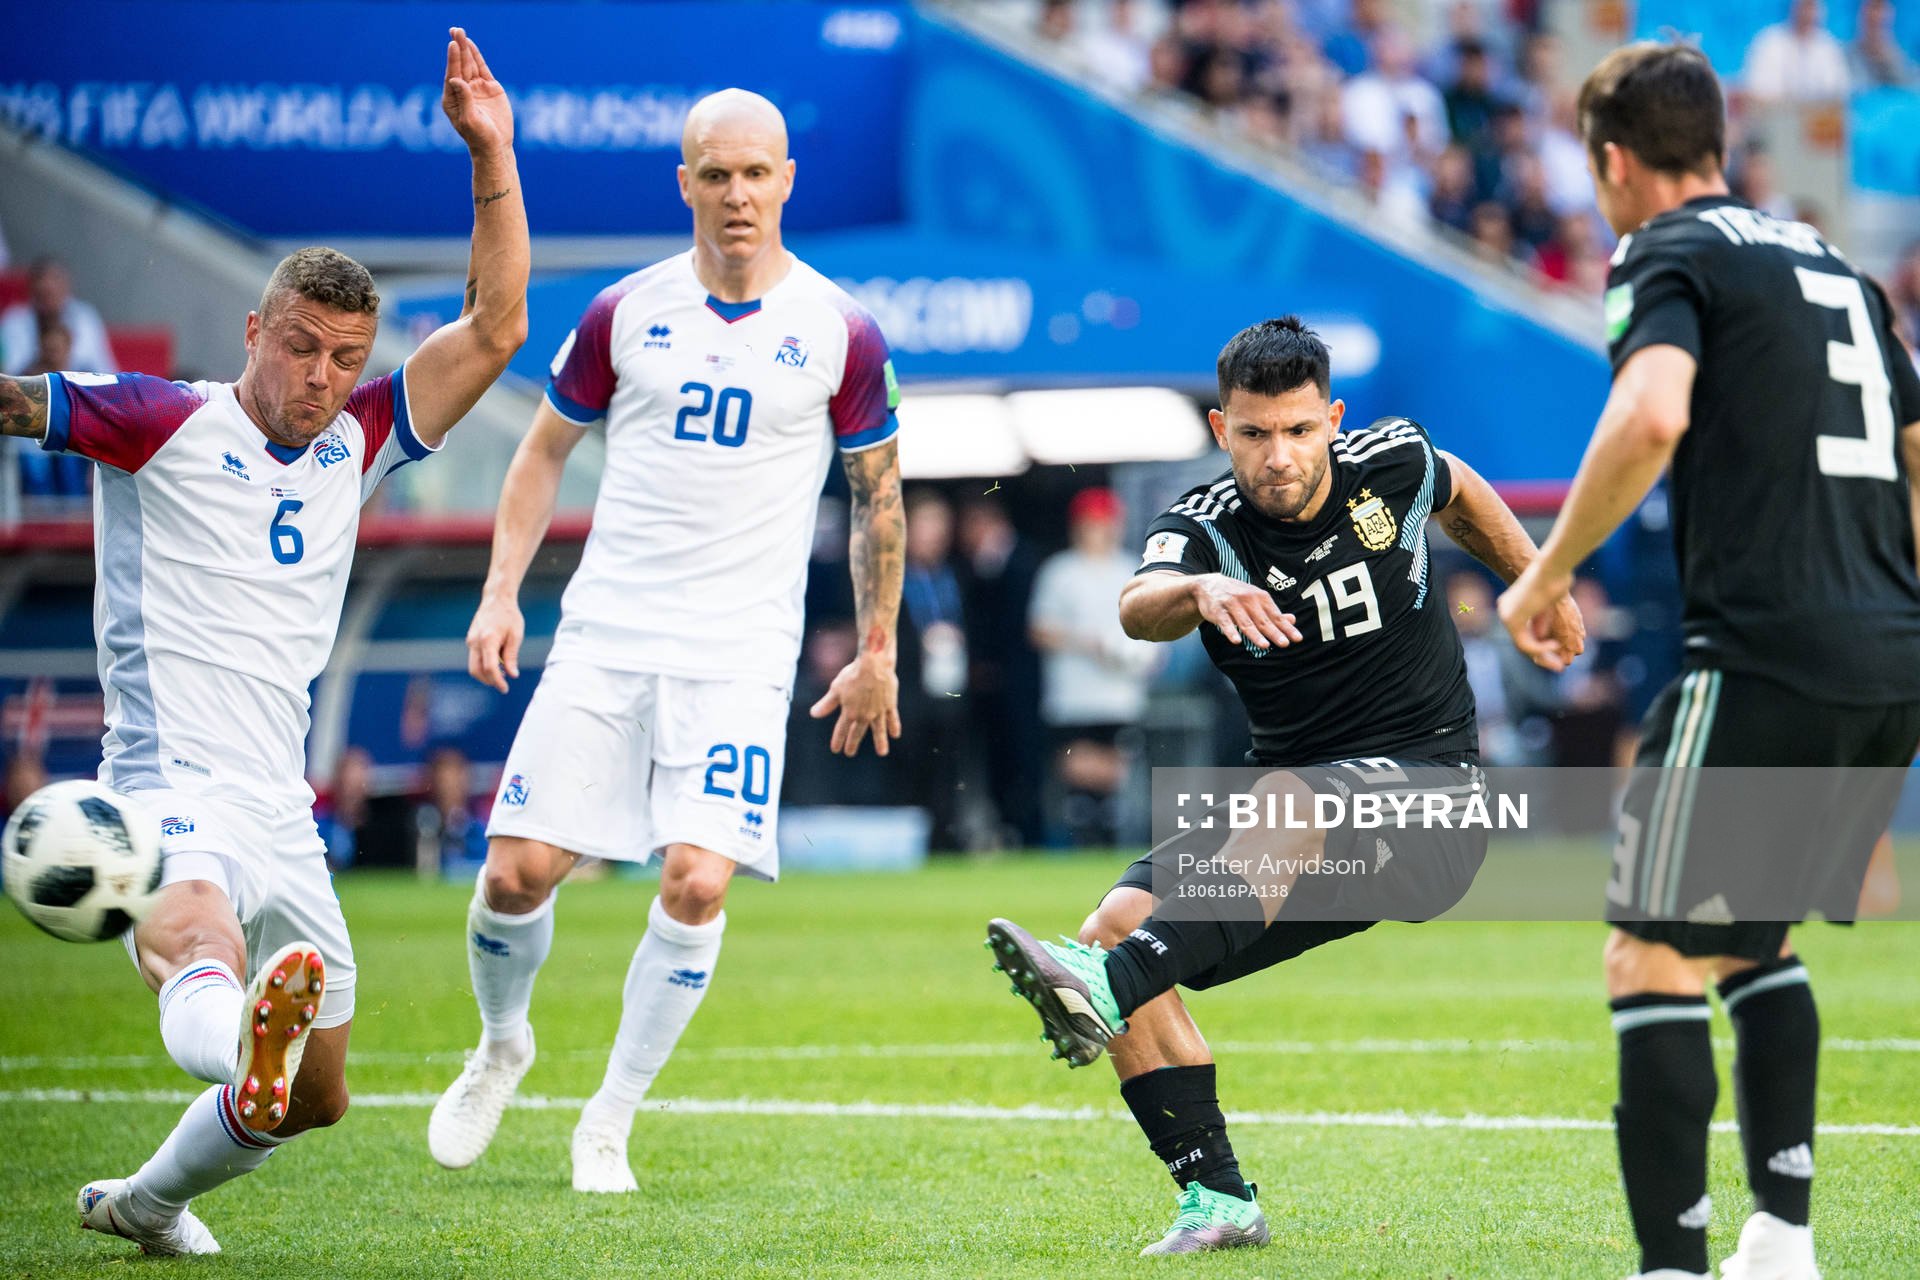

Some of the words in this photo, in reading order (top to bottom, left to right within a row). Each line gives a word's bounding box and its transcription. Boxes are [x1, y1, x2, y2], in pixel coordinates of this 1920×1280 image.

[1793, 266, 1899, 482] 3
[674, 381, 753, 448] 20
[269, 499, 304, 565] 6
[1301, 560, 1383, 642] 19
[703, 743, 771, 806] 20
